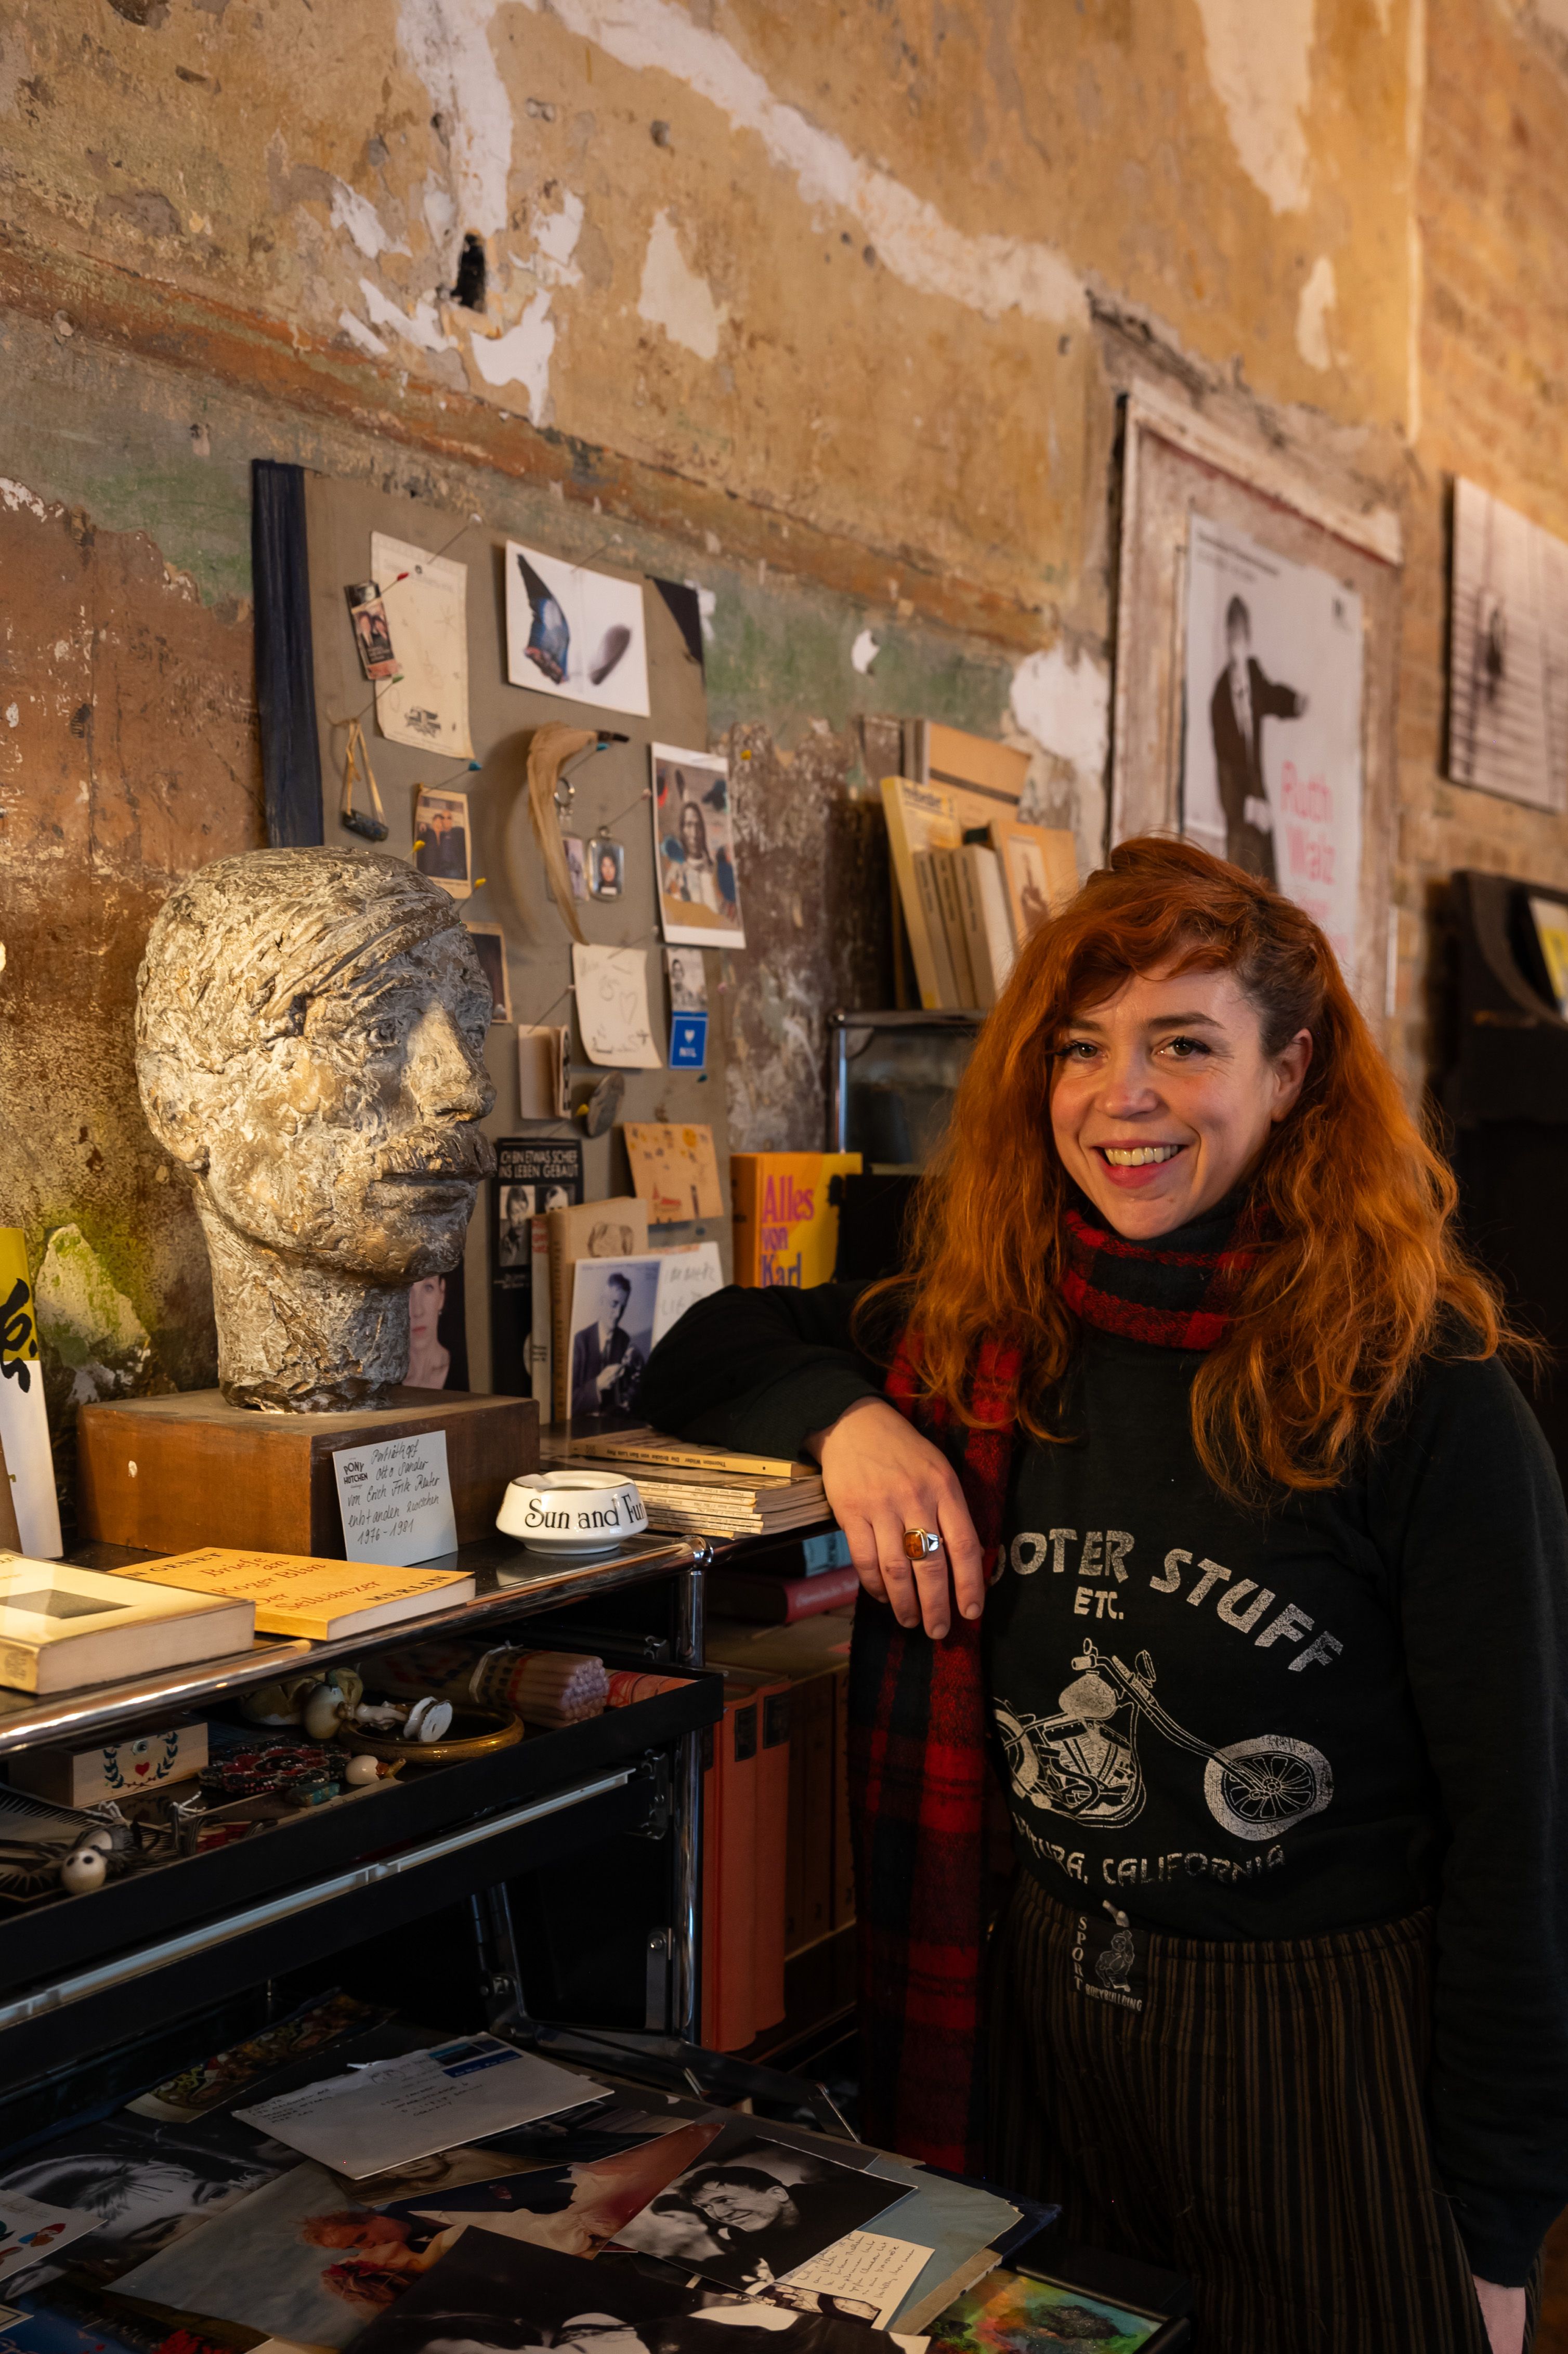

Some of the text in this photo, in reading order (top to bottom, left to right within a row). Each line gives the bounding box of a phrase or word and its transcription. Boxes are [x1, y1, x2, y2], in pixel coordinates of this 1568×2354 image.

[762, 1174, 815, 1223] Alles
[761, 1227, 789, 1251] von
[760, 1251, 803, 1289] Karl
[343, 1461, 364, 1475] PONY
[376, 1457, 428, 1481] Otto Sander
[348, 1494, 361, 1507] von
[367, 1484, 386, 1502] Erich
[525, 1493, 646, 1529] Sun and Fun
[150, 1552, 224, 1572] GENET
[198, 1557, 268, 1577] Briefe
[263, 1559, 290, 1571] an
[209, 1563, 326, 1594] Roger Blin
[364, 1575, 451, 1602] MERLIN
[990, 1528, 1344, 1672] OTER STUFF
[1074, 1586, 1124, 1620] ETC.
[1102, 1845, 1286, 1888] CALIFORNIA
[1072, 1916, 1087, 1991] SPORT
[1084, 1983, 1143, 2011] BODYBUILDING
